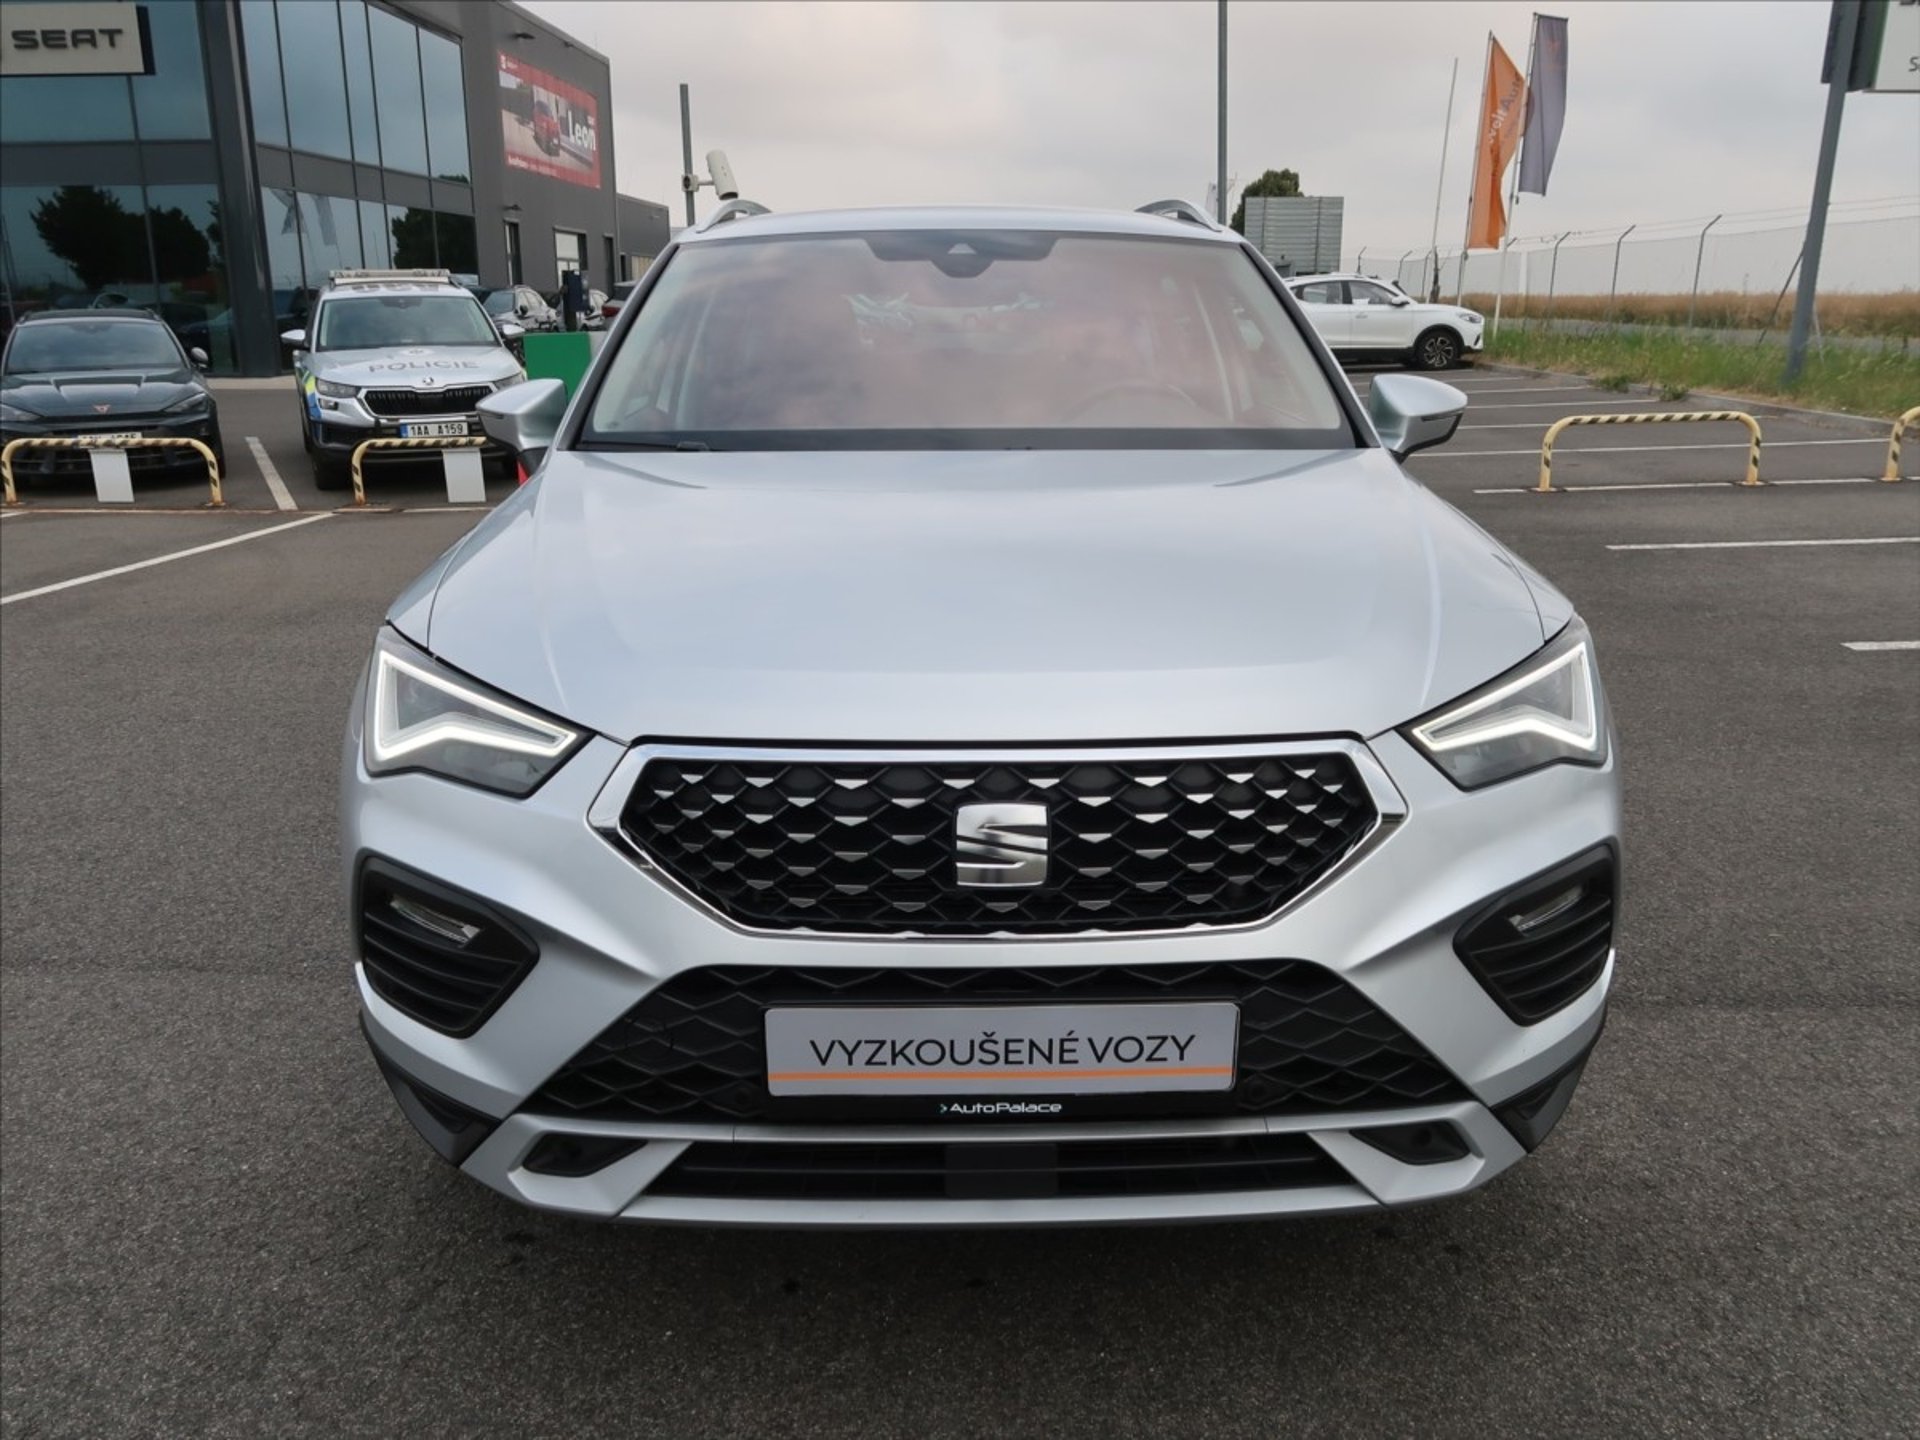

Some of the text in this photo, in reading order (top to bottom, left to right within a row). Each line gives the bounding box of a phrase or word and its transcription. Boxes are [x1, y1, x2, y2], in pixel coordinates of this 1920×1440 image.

[11, 28, 123, 50] SEAT
[567, 109, 597, 151] Leon
[368, 361, 480, 372] POLICIE
[410, 423, 463, 436] 1AA A159
[809, 1030, 1196, 1067] VYZKOUŠENÉ VOZY
[950, 1102, 1062, 1114] AutoPalace
